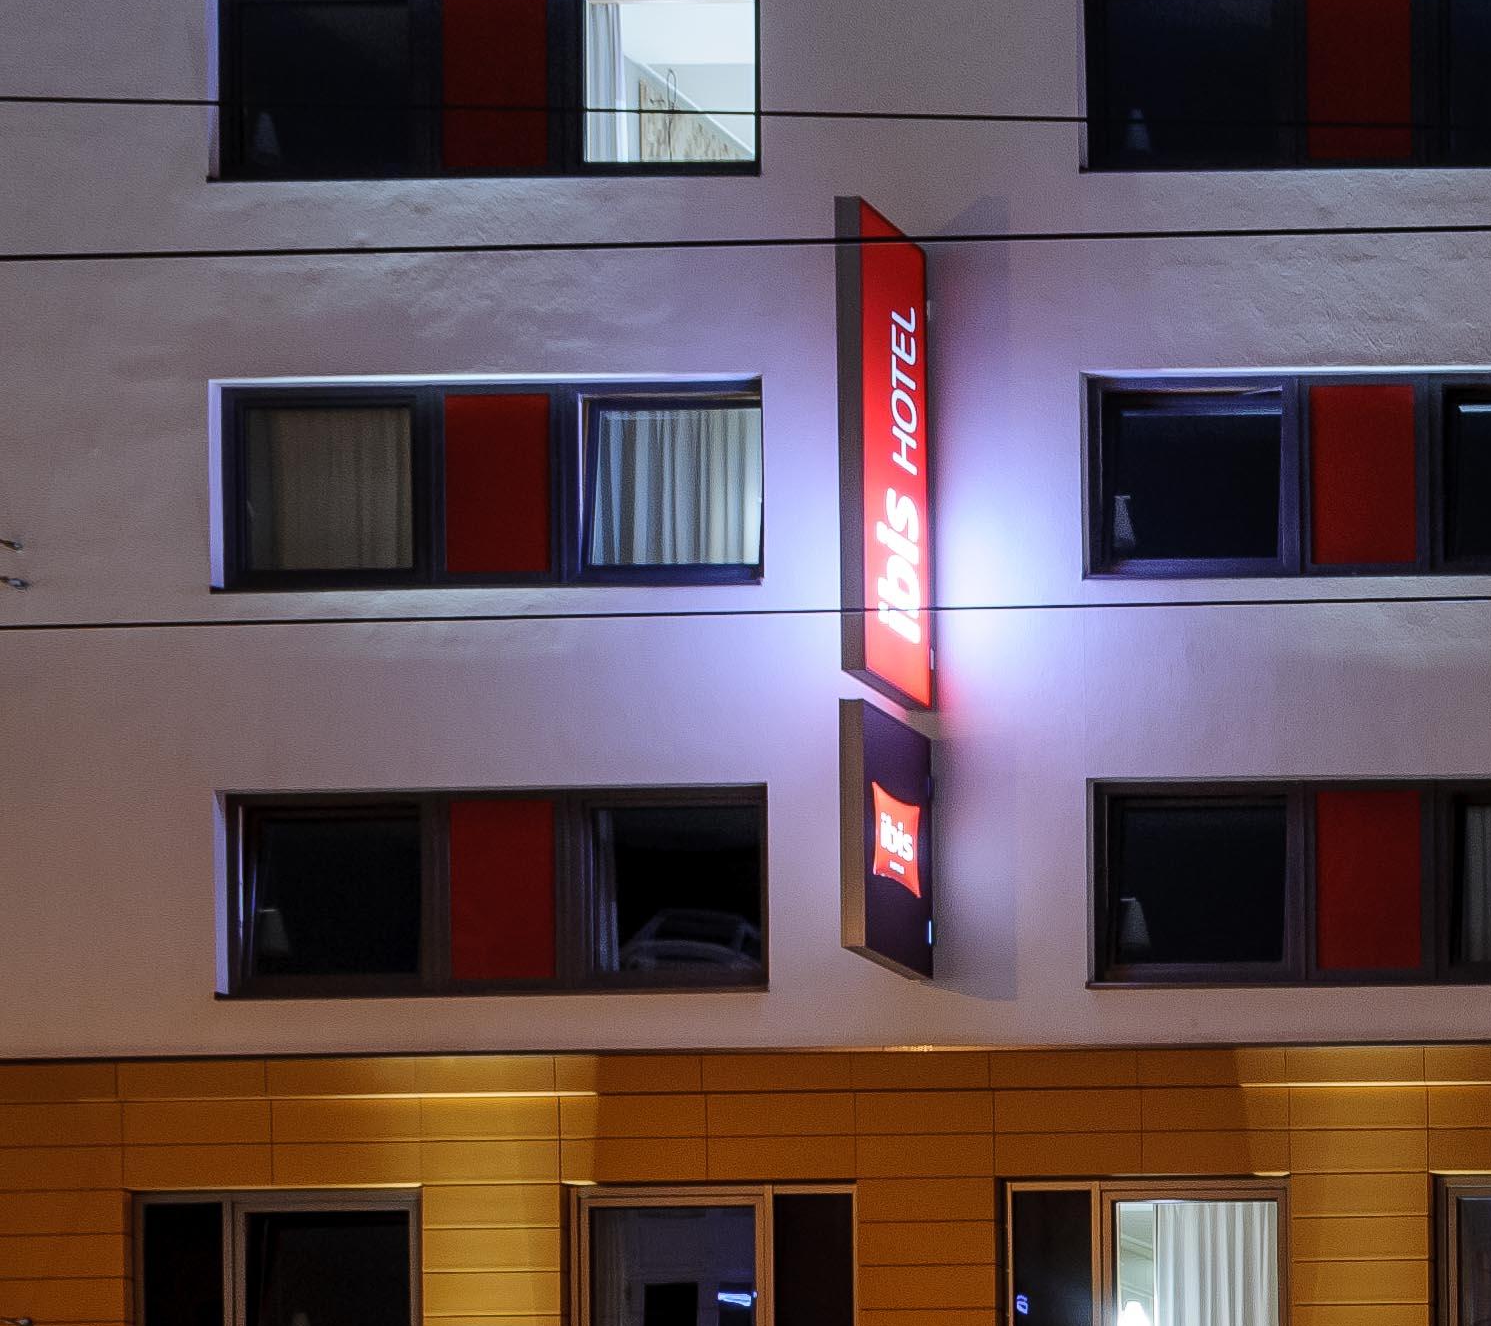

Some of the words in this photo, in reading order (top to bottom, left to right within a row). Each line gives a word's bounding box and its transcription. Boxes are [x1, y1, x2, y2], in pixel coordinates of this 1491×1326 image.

[891, 307, 918, 475] HOTEL
[876, 487, 921, 644] ibis
[880, 811, 914, 862] ibis
